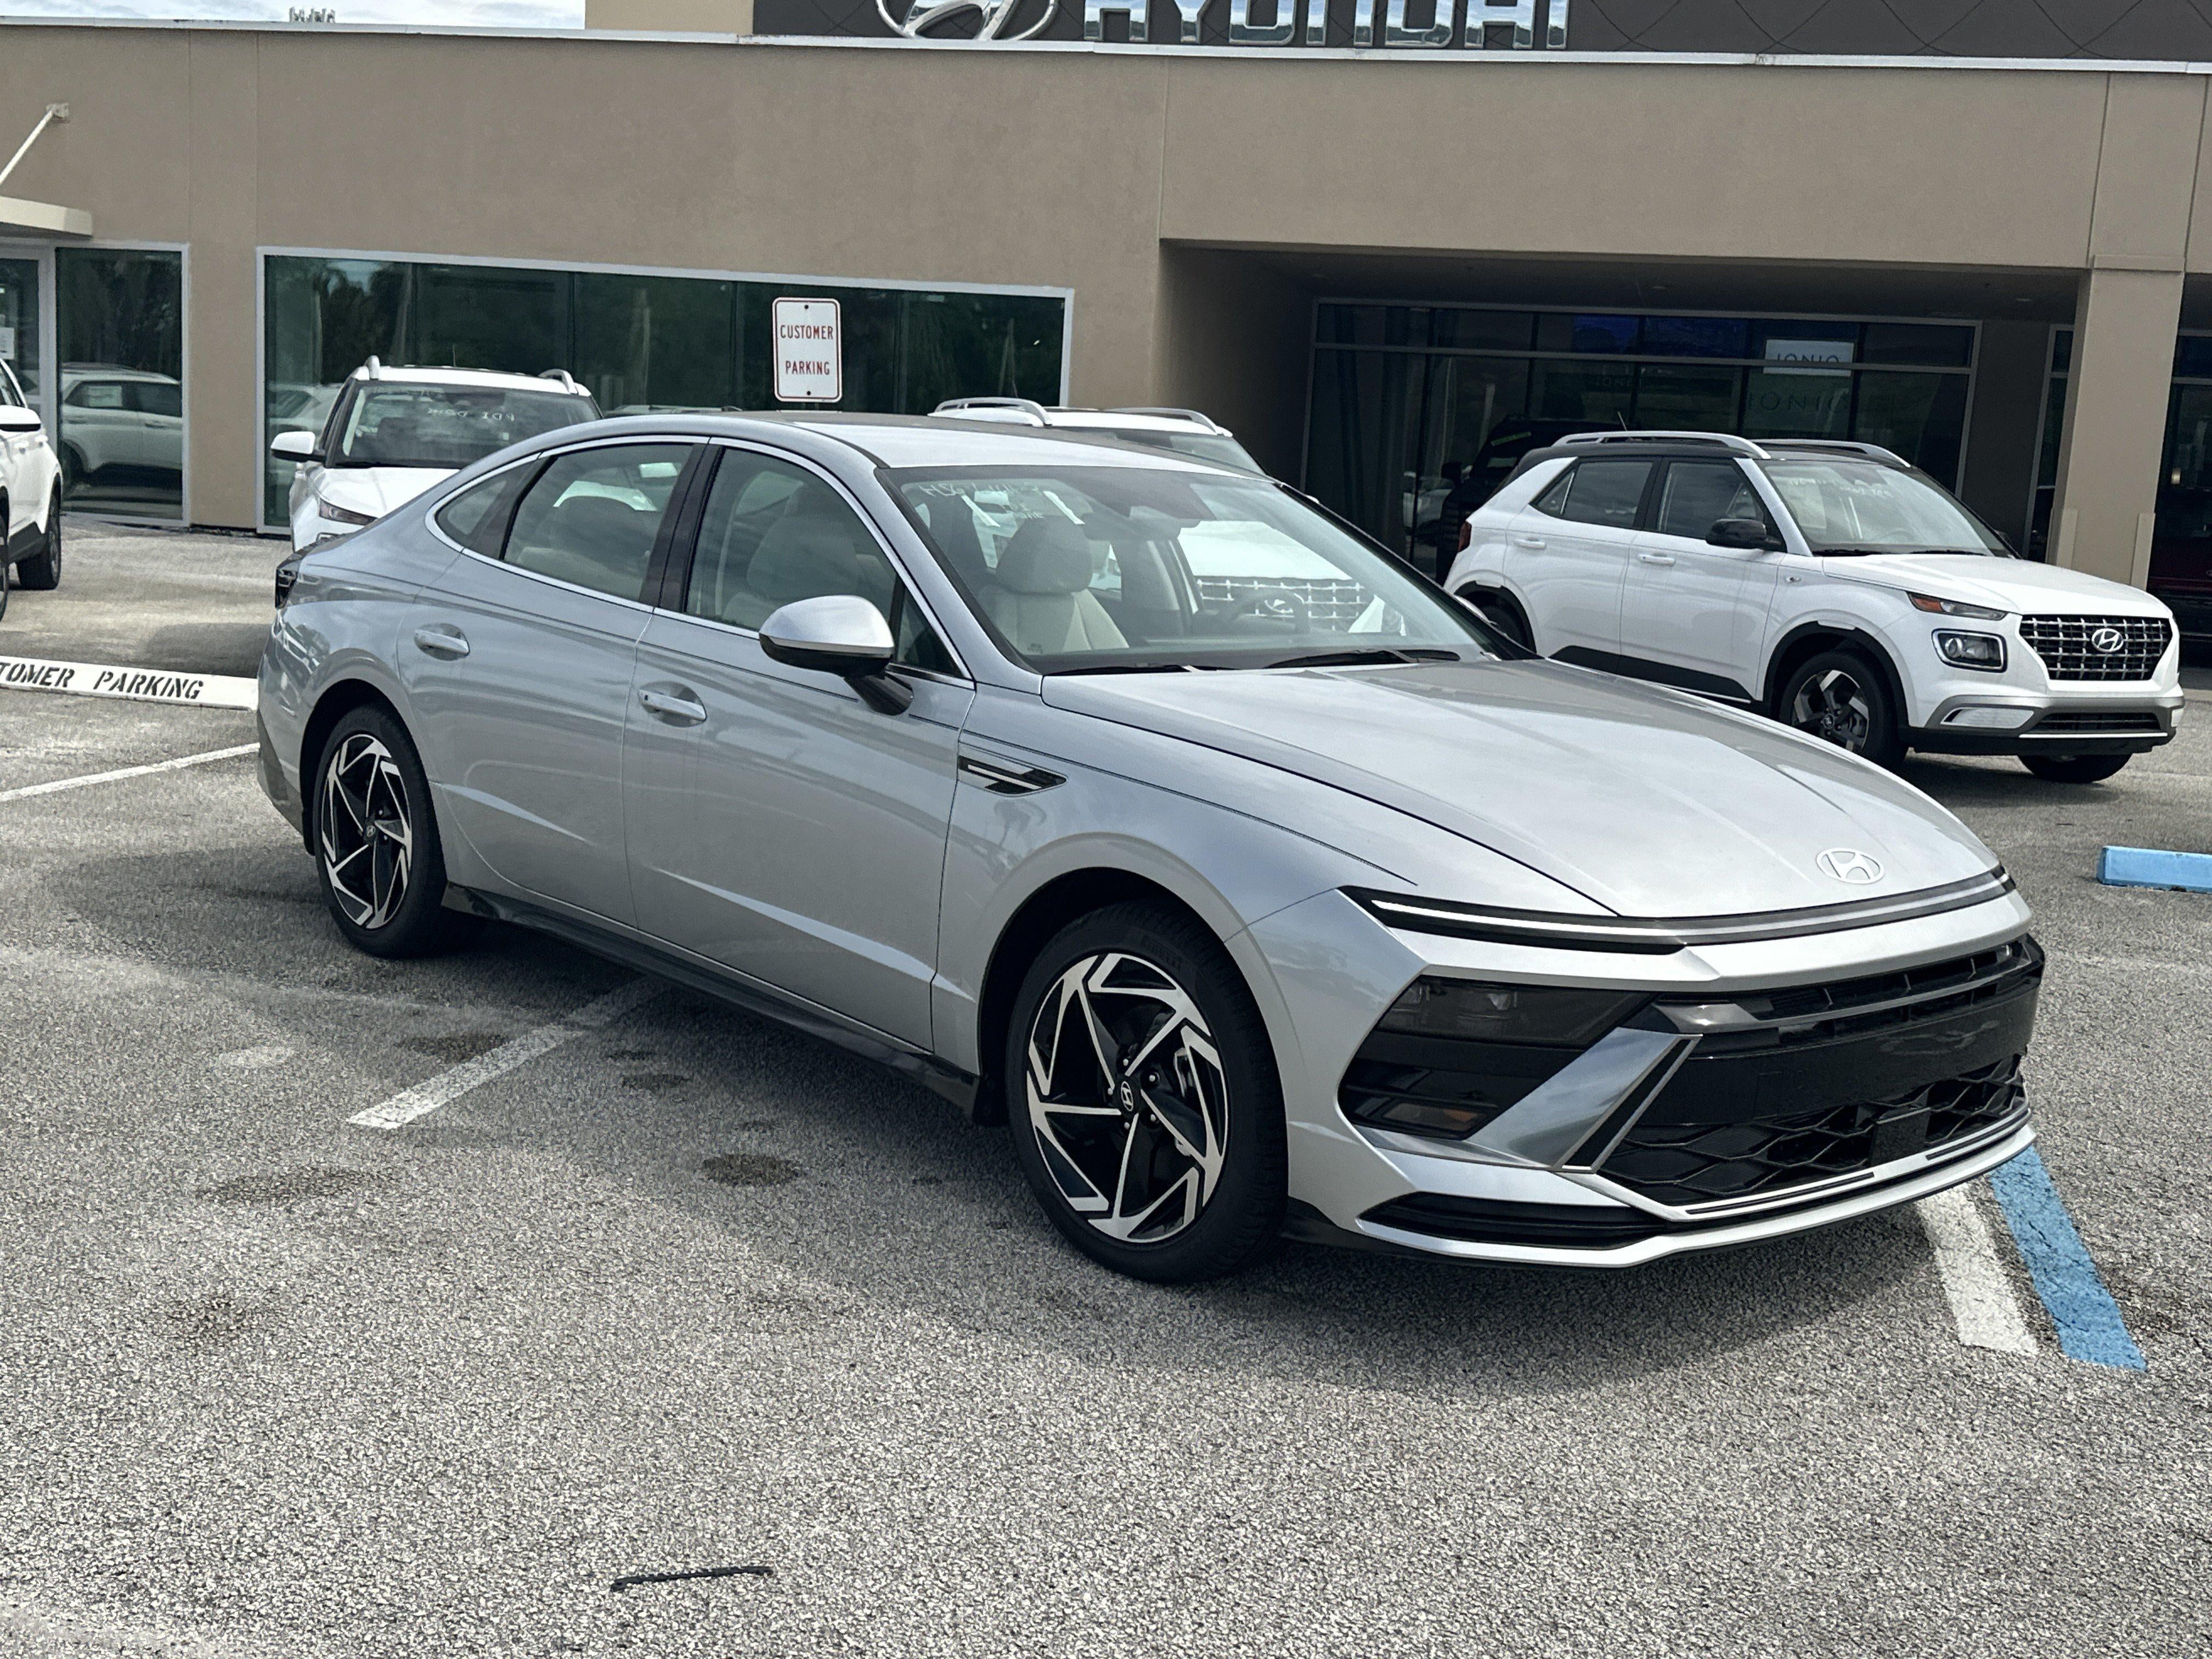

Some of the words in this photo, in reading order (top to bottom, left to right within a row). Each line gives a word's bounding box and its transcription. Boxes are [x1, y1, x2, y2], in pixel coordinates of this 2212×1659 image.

[780, 325, 833, 339] CUSTOMER
[785, 360, 830, 375] PARKING
[93, 670, 204, 699] PARKING
